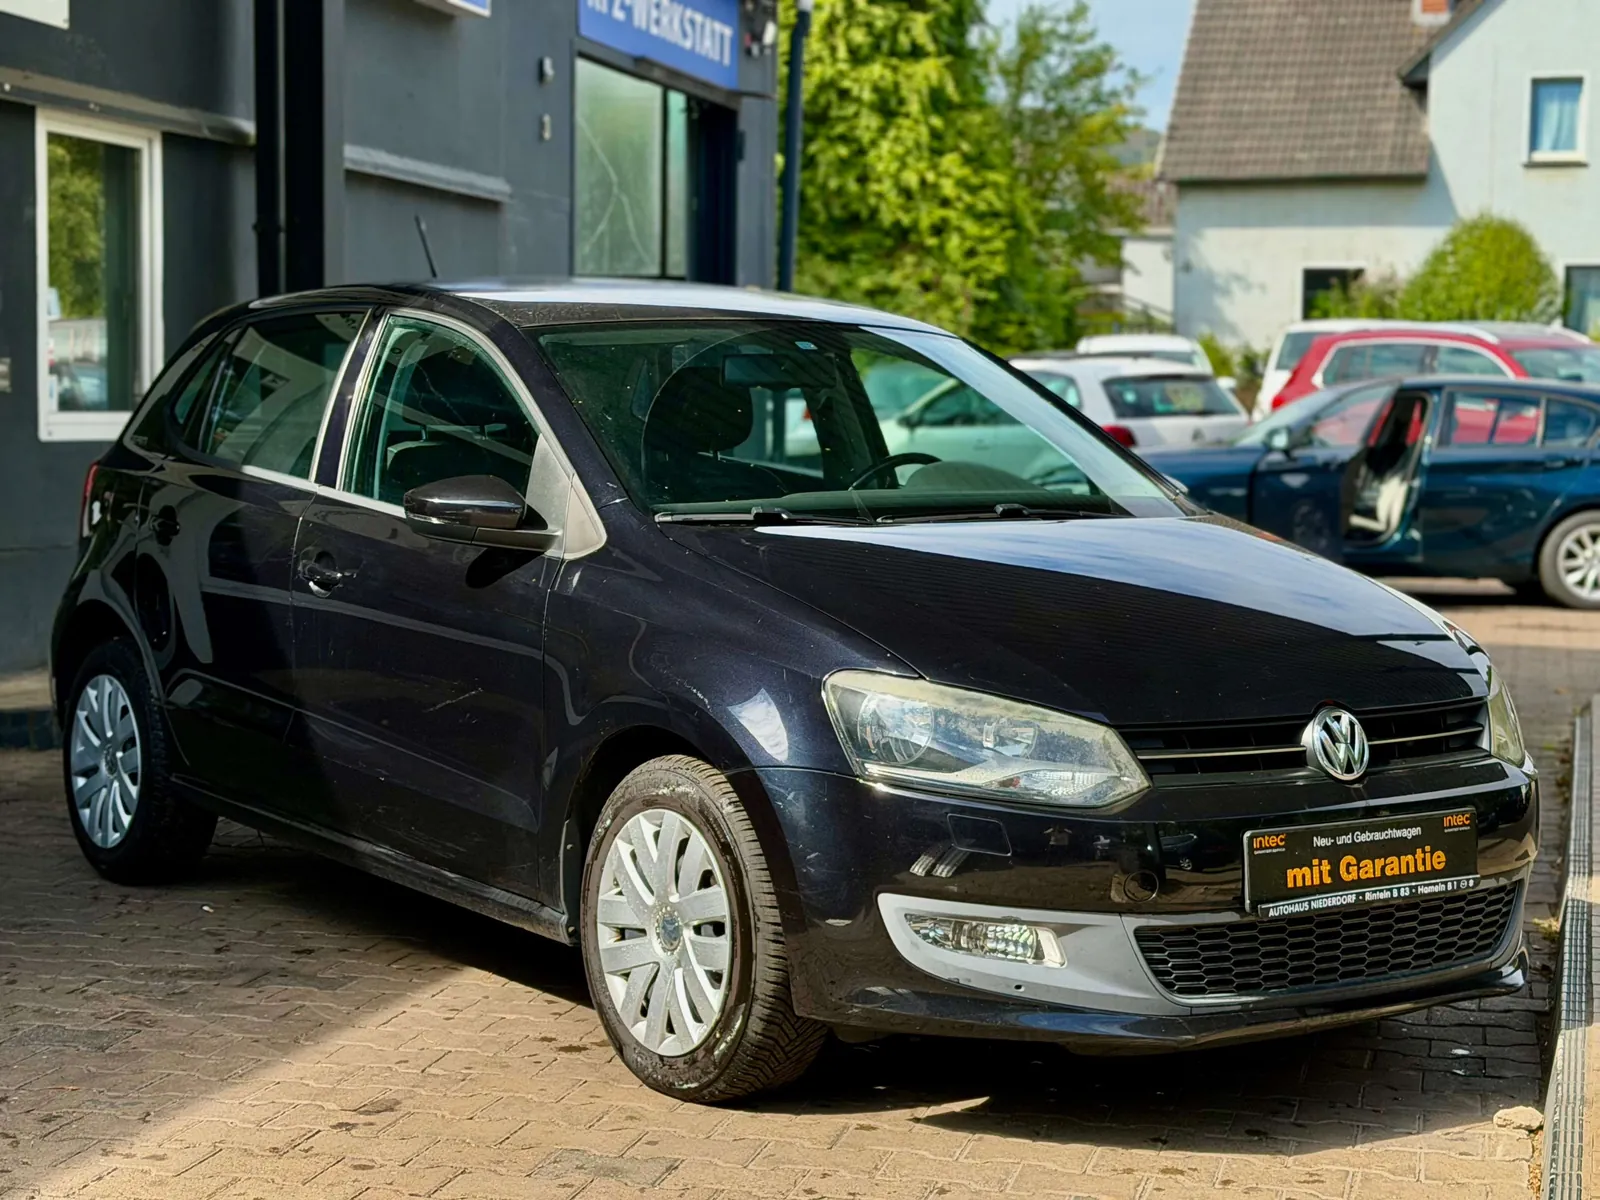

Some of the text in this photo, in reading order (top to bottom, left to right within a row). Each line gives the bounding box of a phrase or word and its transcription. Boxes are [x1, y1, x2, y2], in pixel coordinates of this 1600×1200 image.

[587, 0, 733, 67] Z-WERKSTATT
[1443, 813, 1471, 827] intec
[1253, 834, 1286, 849] intec
[1313, 827, 1422, 848] Neu- und Gebrauchtwagen
[1286, 845, 1447, 888] mit Garantie
[1268, 902, 1309, 917] AUTOHAUS
[1311, 894, 1356, 909] NIEDERDORF
[1365, 890, 1391, 902] Rinteln
[1392, 888, 1398, 898] B
